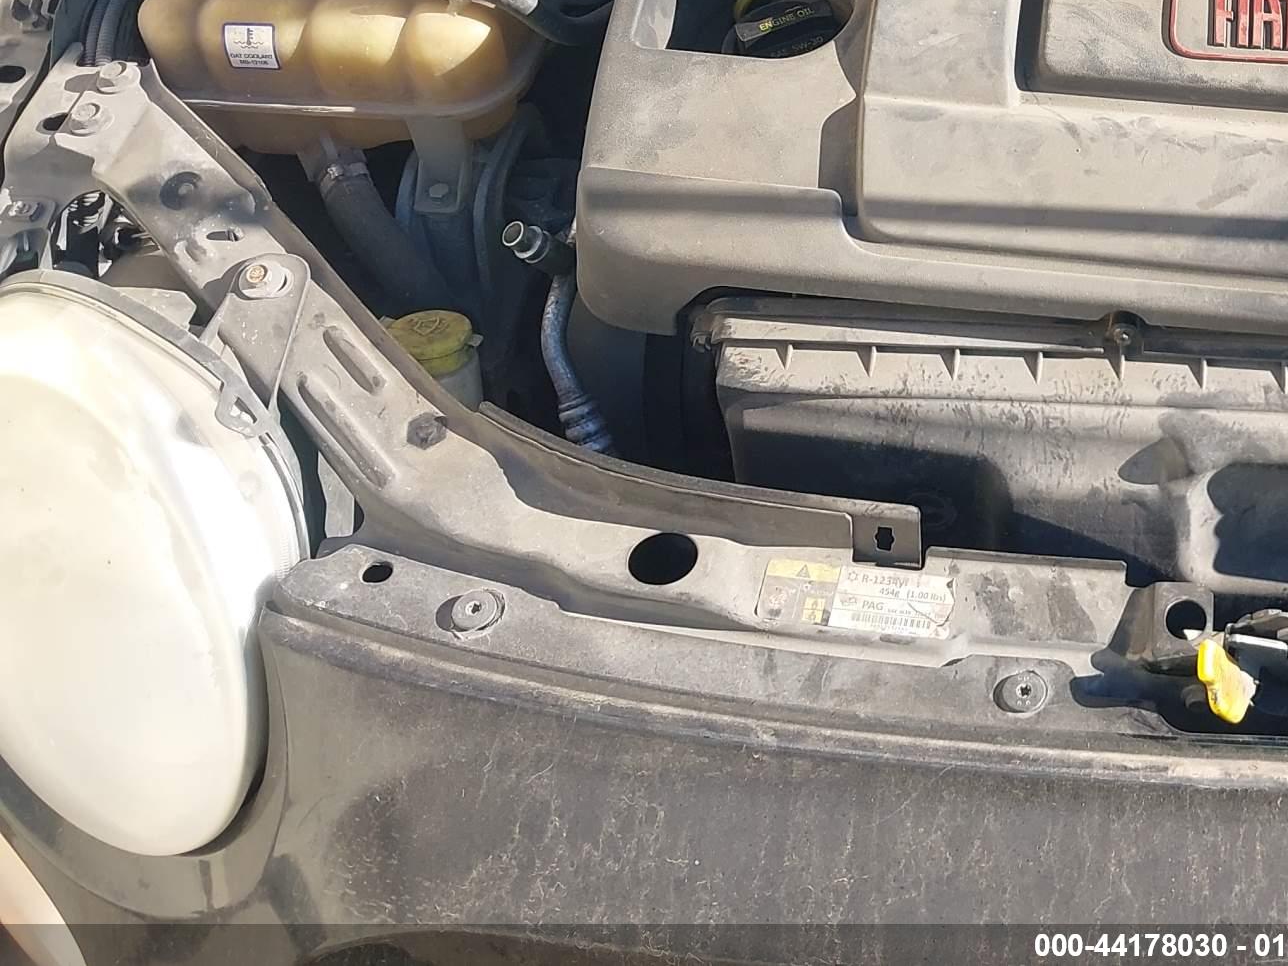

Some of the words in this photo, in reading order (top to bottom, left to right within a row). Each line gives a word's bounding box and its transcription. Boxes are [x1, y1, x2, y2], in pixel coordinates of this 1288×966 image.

[759, 12, 795, 32] ENGINE
[797, 6, 816, 19] OIL
[862, 599, 884, 611] PAG
